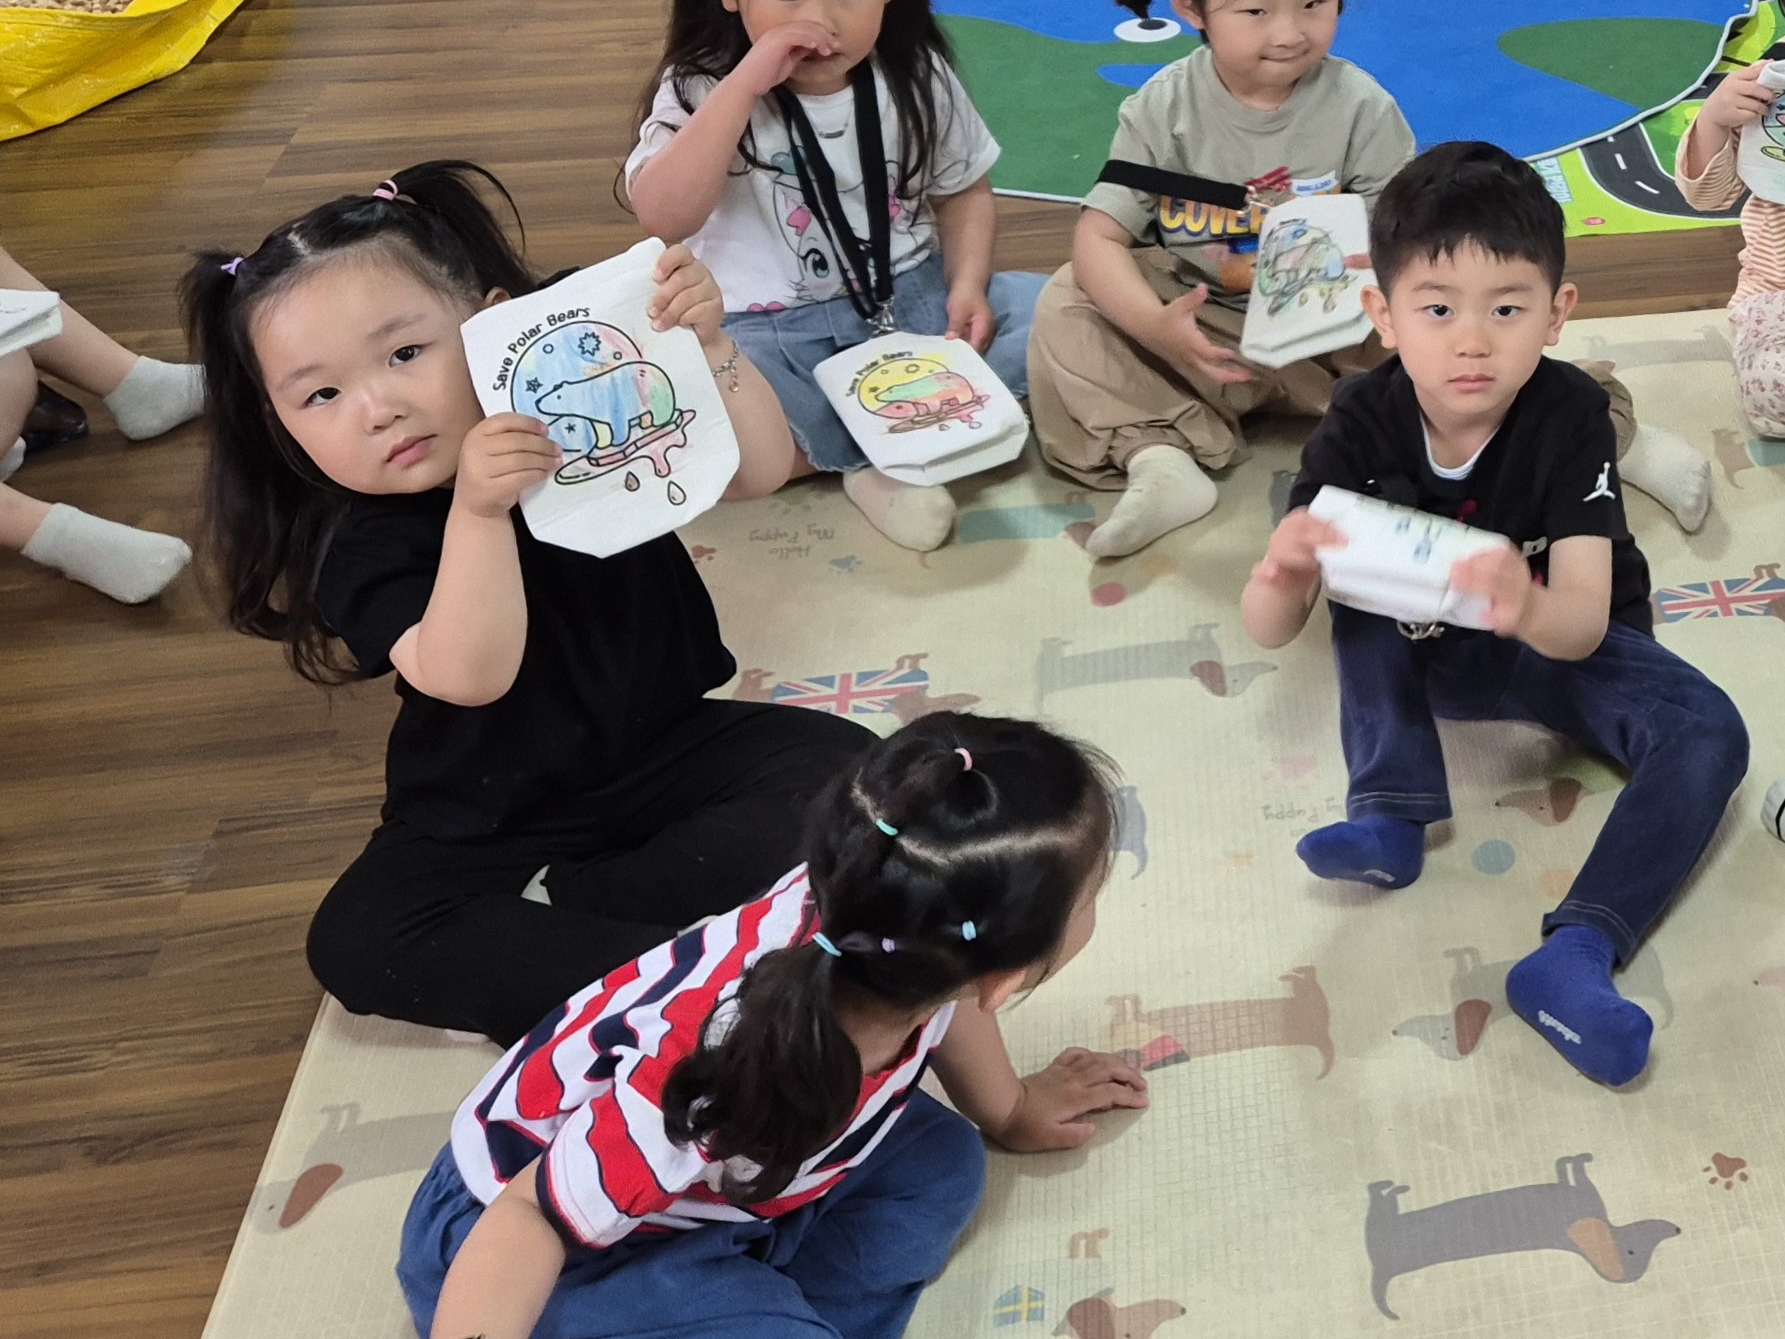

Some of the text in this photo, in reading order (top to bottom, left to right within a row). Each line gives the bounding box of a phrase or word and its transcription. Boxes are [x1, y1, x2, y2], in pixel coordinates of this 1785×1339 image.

[493, 306, 591, 392] Save Polar Bears
